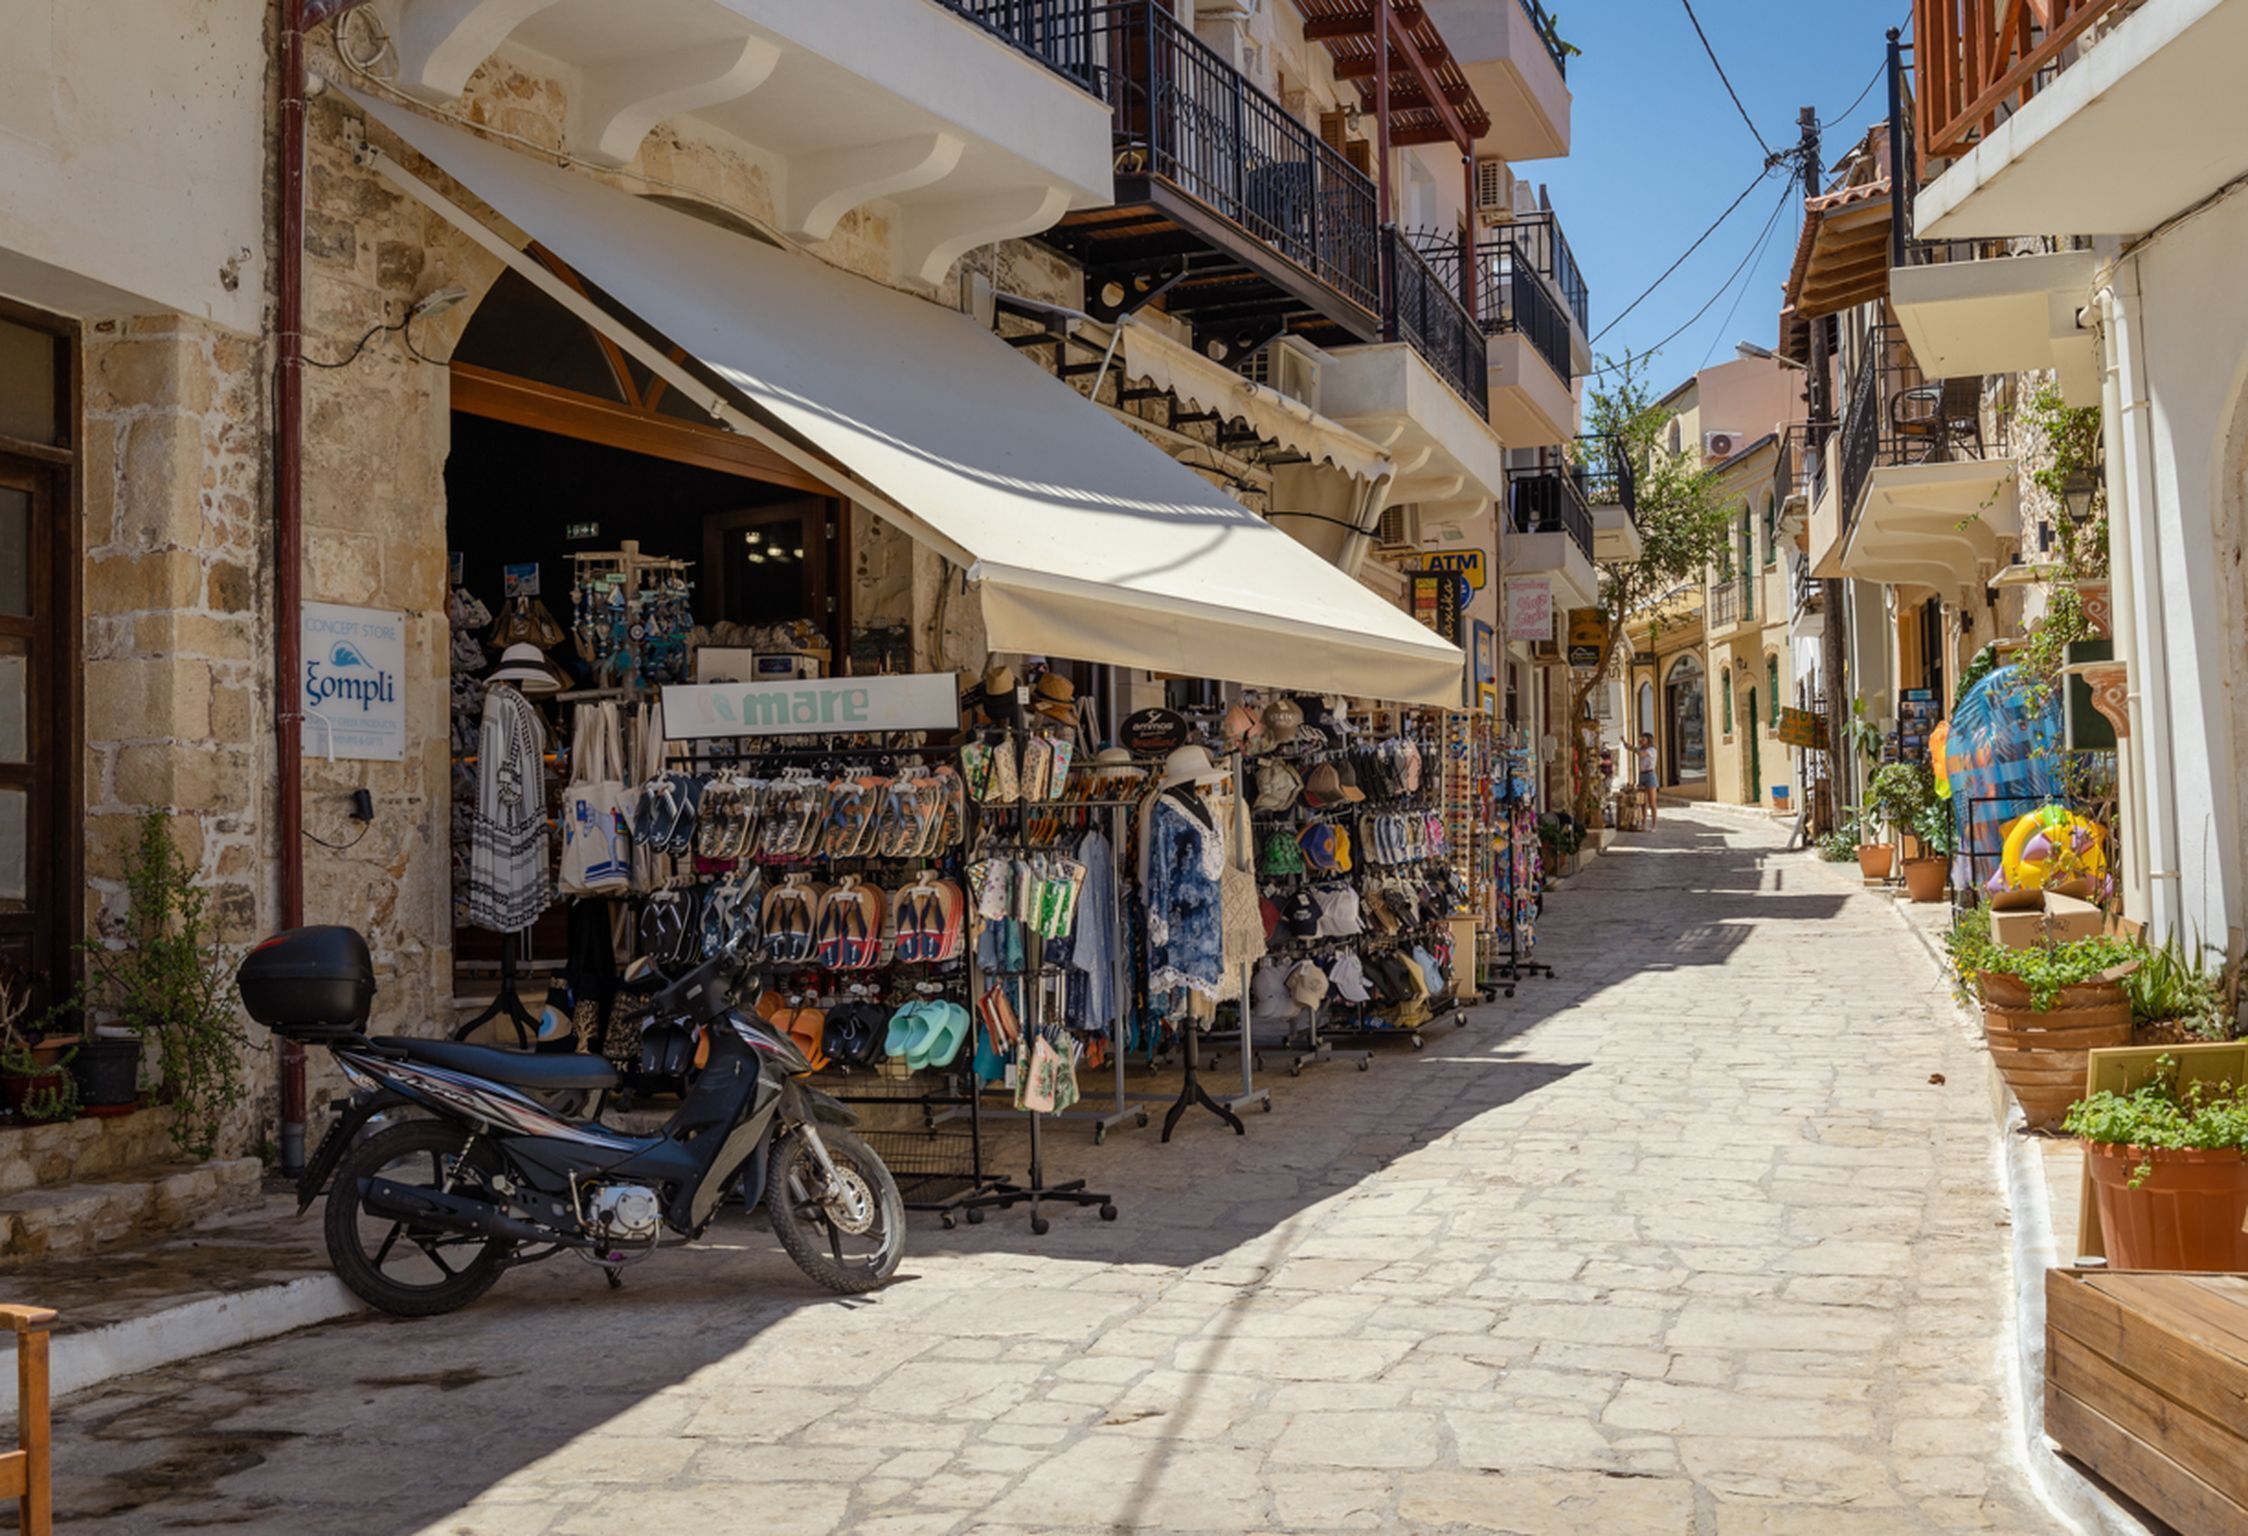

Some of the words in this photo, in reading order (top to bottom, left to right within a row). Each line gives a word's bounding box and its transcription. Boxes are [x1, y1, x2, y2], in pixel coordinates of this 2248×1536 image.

[1429, 554, 1478, 572] ATM
[304, 616, 359, 636] CONCEPT
[361, 623, 397, 641] STORE
[742, 688, 870, 726] mare
